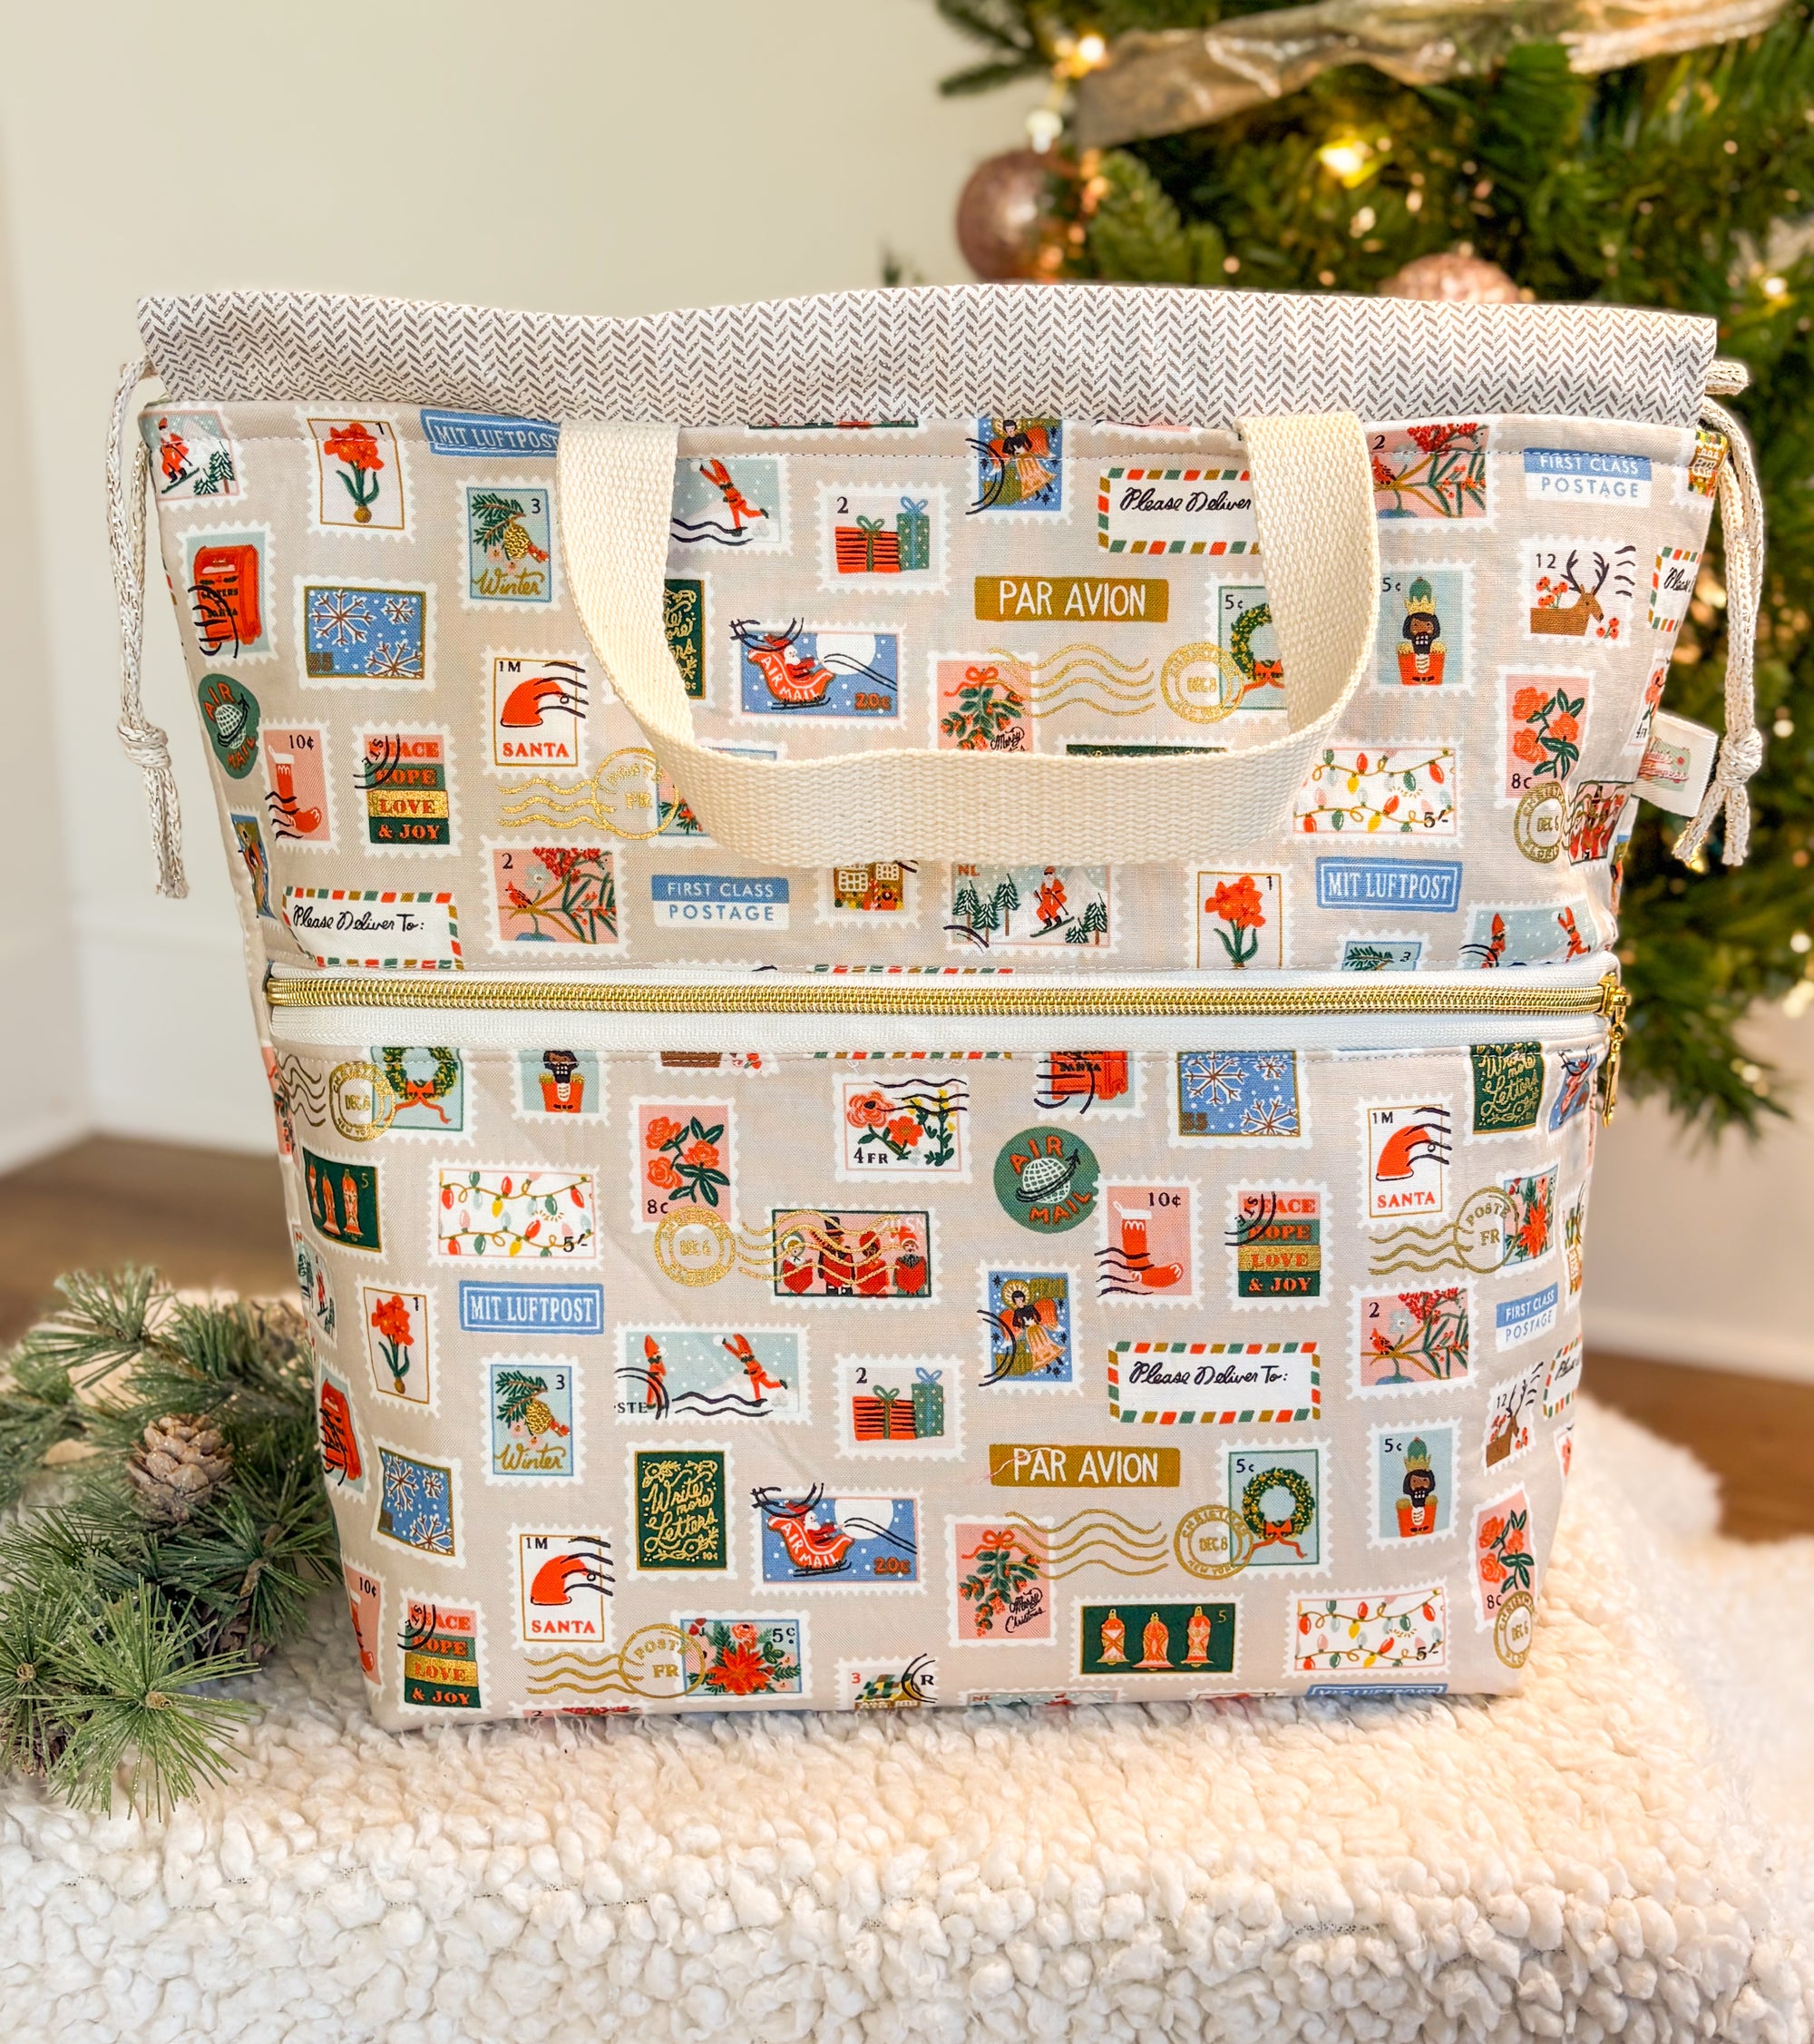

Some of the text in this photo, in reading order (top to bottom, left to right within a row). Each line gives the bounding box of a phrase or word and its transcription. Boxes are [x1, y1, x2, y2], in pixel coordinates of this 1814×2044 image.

[375, 421, 385, 435] 1
[435, 425, 466, 445] MIT
[1372, 435, 1386, 451] 2
[1540, 455, 1639, 474] FIRST CLASS
[1542, 477, 1639, 498] POSTAGE
[531, 497, 541, 514] 3
[837, 496, 849, 514] 2
[1119, 486, 1252, 513] Please Deliver
[1536, 553, 1557, 570] 12
[472, 567, 546, 596] Winter
[1000, 580, 1146, 617] PAR AVION
[762, 656, 816, 701] AIR MAIL
[202, 682, 237, 722] AIR
[289, 733, 314, 751] 10¢
[502, 741, 571, 758] SANTA
[379, 799, 436, 815] LOVE
[377, 824, 440, 840] & JOY
[502, 853, 514, 870] 2
[668, 881, 775, 899] FIRST CLASS
[1266, 875, 1273, 891] 1
[1328, 871, 1452, 900] MIT LUFTPOST
[293, 904, 425, 933] Please Deliver To:
[668, 904, 775, 923] POSTAGE
[1400, 951, 1412, 963] 3
[1009, 1135, 1064, 1175] AIR
[361, 1173, 369, 1188] 5
[1029, 1191, 1092, 1225] MAIL
[1148, 1192, 1182, 1208] 10¢
[1377, 1190, 1436, 1208] SANTA
[1247, 1225, 1312, 1241] HOPE
[1479, 1228, 1500, 1247] FR
[1251, 1252, 1308, 1268] LOVE
[1248, 1276, 1312, 1292] & JOY
[413, 1296, 419, 1312] 1
[471, 1296, 594, 1324] MIT LUFTPOST
[1369, 1302, 1380, 1318] 2
[1506, 1289, 1555, 1322] FIRST CLASS
[1506, 1308, 1554, 1344] POSTAGE
[555, 1374, 566, 1390] 3
[855, 1367, 868, 1384] 2
[1128, 1361, 1289, 1386] Please Deliver To:
[1497, 1393, 1507, 1410] 12
[495, 1443, 567, 1472] Winter
[1013, 1447, 1158, 1484] PAR AVION
[642, 1469, 713, 1515] Write
[676, 1487, 715, 1516] more
[644, 1508, 718, 1554] Letters
[781, 1522, 840, 1568] AIR MAIL
[359, 1577, 377, 1598] 10¢
[1009, 1587, 1043, 1614] Merry
[1005, 1608, 1047, 1634] Christmas
[1218, 1609, 1227, 1624] 5
[532, 1619, 596, 1634] SANTA
[413, 1635, 468, 1657] HOPE
[414, 1662, 466, 1682] LOVE
[653, 1663, 680, 1678] FR
[851, 1672, 862, 1685] 3
[412, 1687, 471, 1706] & JOY
